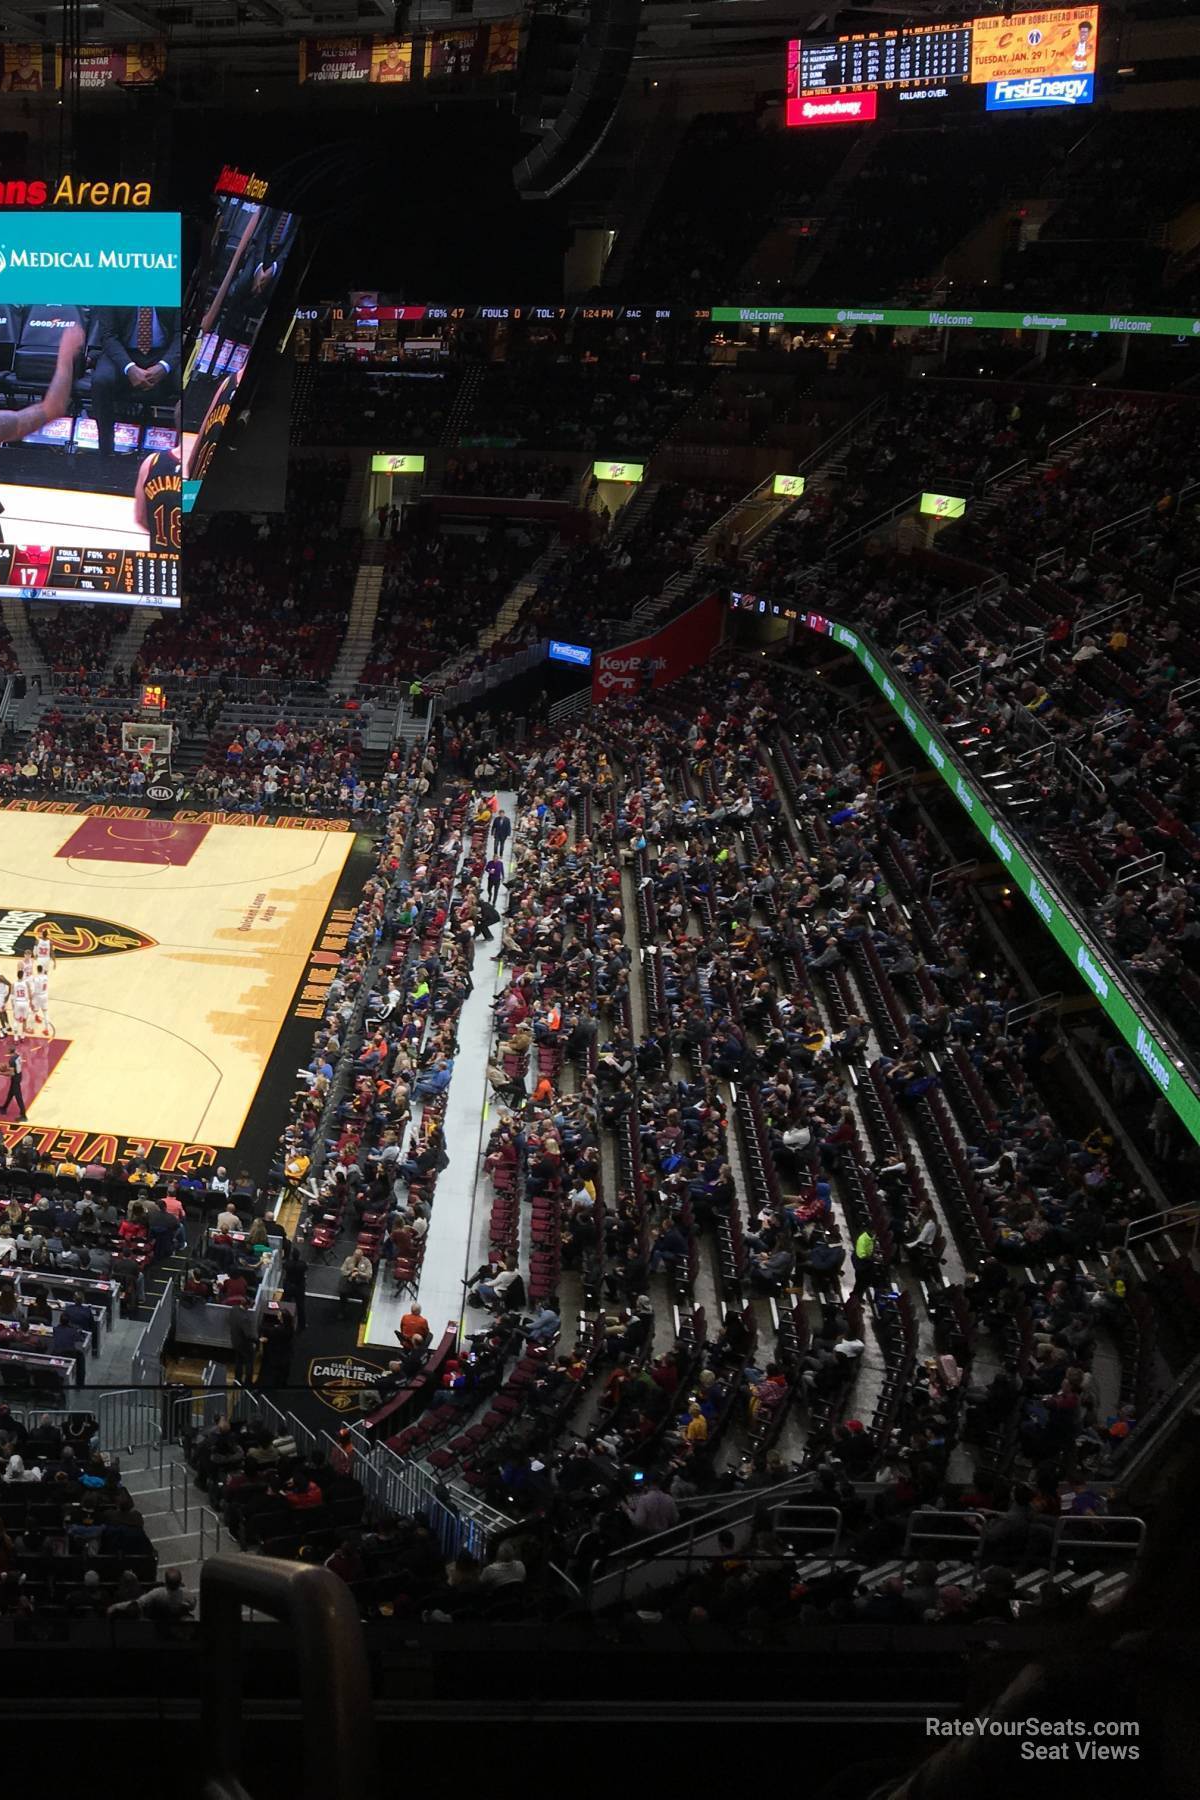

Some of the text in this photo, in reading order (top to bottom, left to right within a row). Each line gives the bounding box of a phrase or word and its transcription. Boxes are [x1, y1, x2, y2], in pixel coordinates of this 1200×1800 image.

[977, 18, 999, 30] COLLIN
[1028, 11, 1071, 25] BOBBLEHEAD
[1073, 9, 1094, 19] NIGHT
[975, 53, 1009, 65] TUESDAY,
[1011, 51, 1030, 62] JAN.
[1031, 50, 1042, 60] 29
[321, 62, 356, 72] COLLIN'S
[900, 90, 926, 100] DILLARD
[994, 78, 1089, 100] FirstEnergy
[802, 100, 862, 118] Speedway
[53, 175, 152, 206] Arena
[9, 249, 177, 270] MEDICAL MUTUAL
[332, 309, 344, 320] 1Q
[394, 308, 405, 319] 17
[428, 308, 465, 319] FG% 47
[482, 308, 521, 319] FOULS 0
[536, 308, 565, 319] TOL: 7
[583, 309, 614, 318] 1:24 PM
[626, 310, 642, 318] SAC
[740, 309, 784, 320] Welcome
[847, 311, 884, 322] Huntington
[930, 312, 973, 325] Welcome
[29, 318, 76, 328] GOODYEAR
[1031, 316, 1067, 328] Huntington
[1110, 317, 1152, 331] Welcome
[145, 475, 181, 500] DELLAV
[87, 551, 117, 560] FG% 47
[63, 563, 71, 573] 0
[82, 565, 116, 575] 3PT% 33
[20, 568, 38, 585] 17
[81, 580, 110, 590] TOL 7
[599, 656, 667, 672] KeyBnk
[144, 692, 159, 706] 24
[150, 788, 170, 798] KIA
[172, 810, 350, 832] CAVALIERS
[1029, 877, 1052, 923] Welcome
[238, 893, 267, 932] Quicken Loans
[259, 906, 277, 922] Arena
[16, 989, 25, 997] 15
[300, 984, 331, 1001] FOR
[294, 1003, 326, 1020] ALL
[1136, 1025, 1170, 1093] Welcome
[313, 1365, 382, 1384] CAVALIERS
